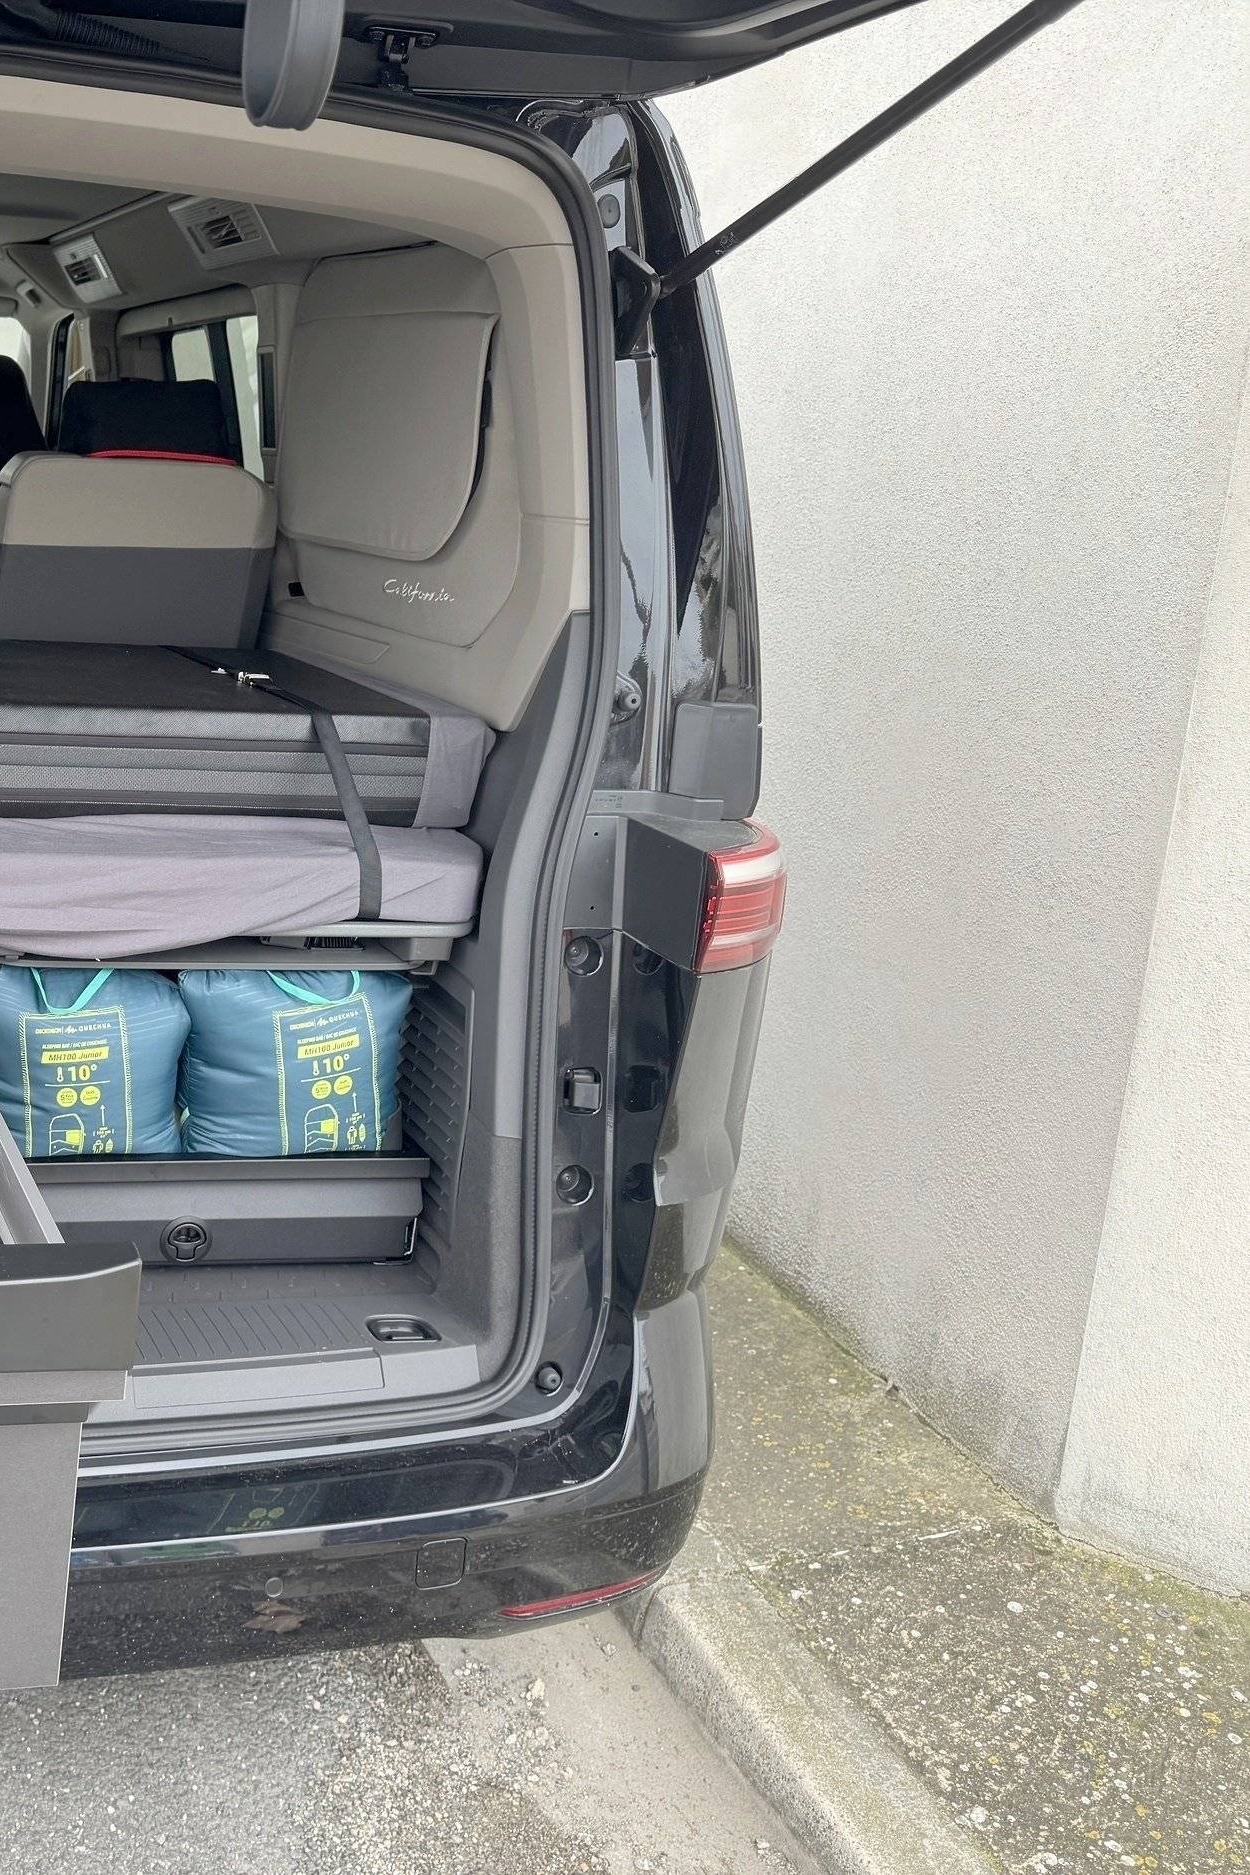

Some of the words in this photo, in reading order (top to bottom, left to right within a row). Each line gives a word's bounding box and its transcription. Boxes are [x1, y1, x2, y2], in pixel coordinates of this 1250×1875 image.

[383, 579, 455, 603] California
[328, 1010, 359, 1022] QUECHUA
[78, 1022, 112, 1032] QUECHUA
[48, 1053, 77, 1062] MH100
[79, 1050, 103, 1060] Junior
[304, 1044, 331, 1056] MH100
[332, 1039, 354, 1051] Junior
[322, 1053, 350, 1074] 10°
[67, 1063, 97, 1082] 10°
